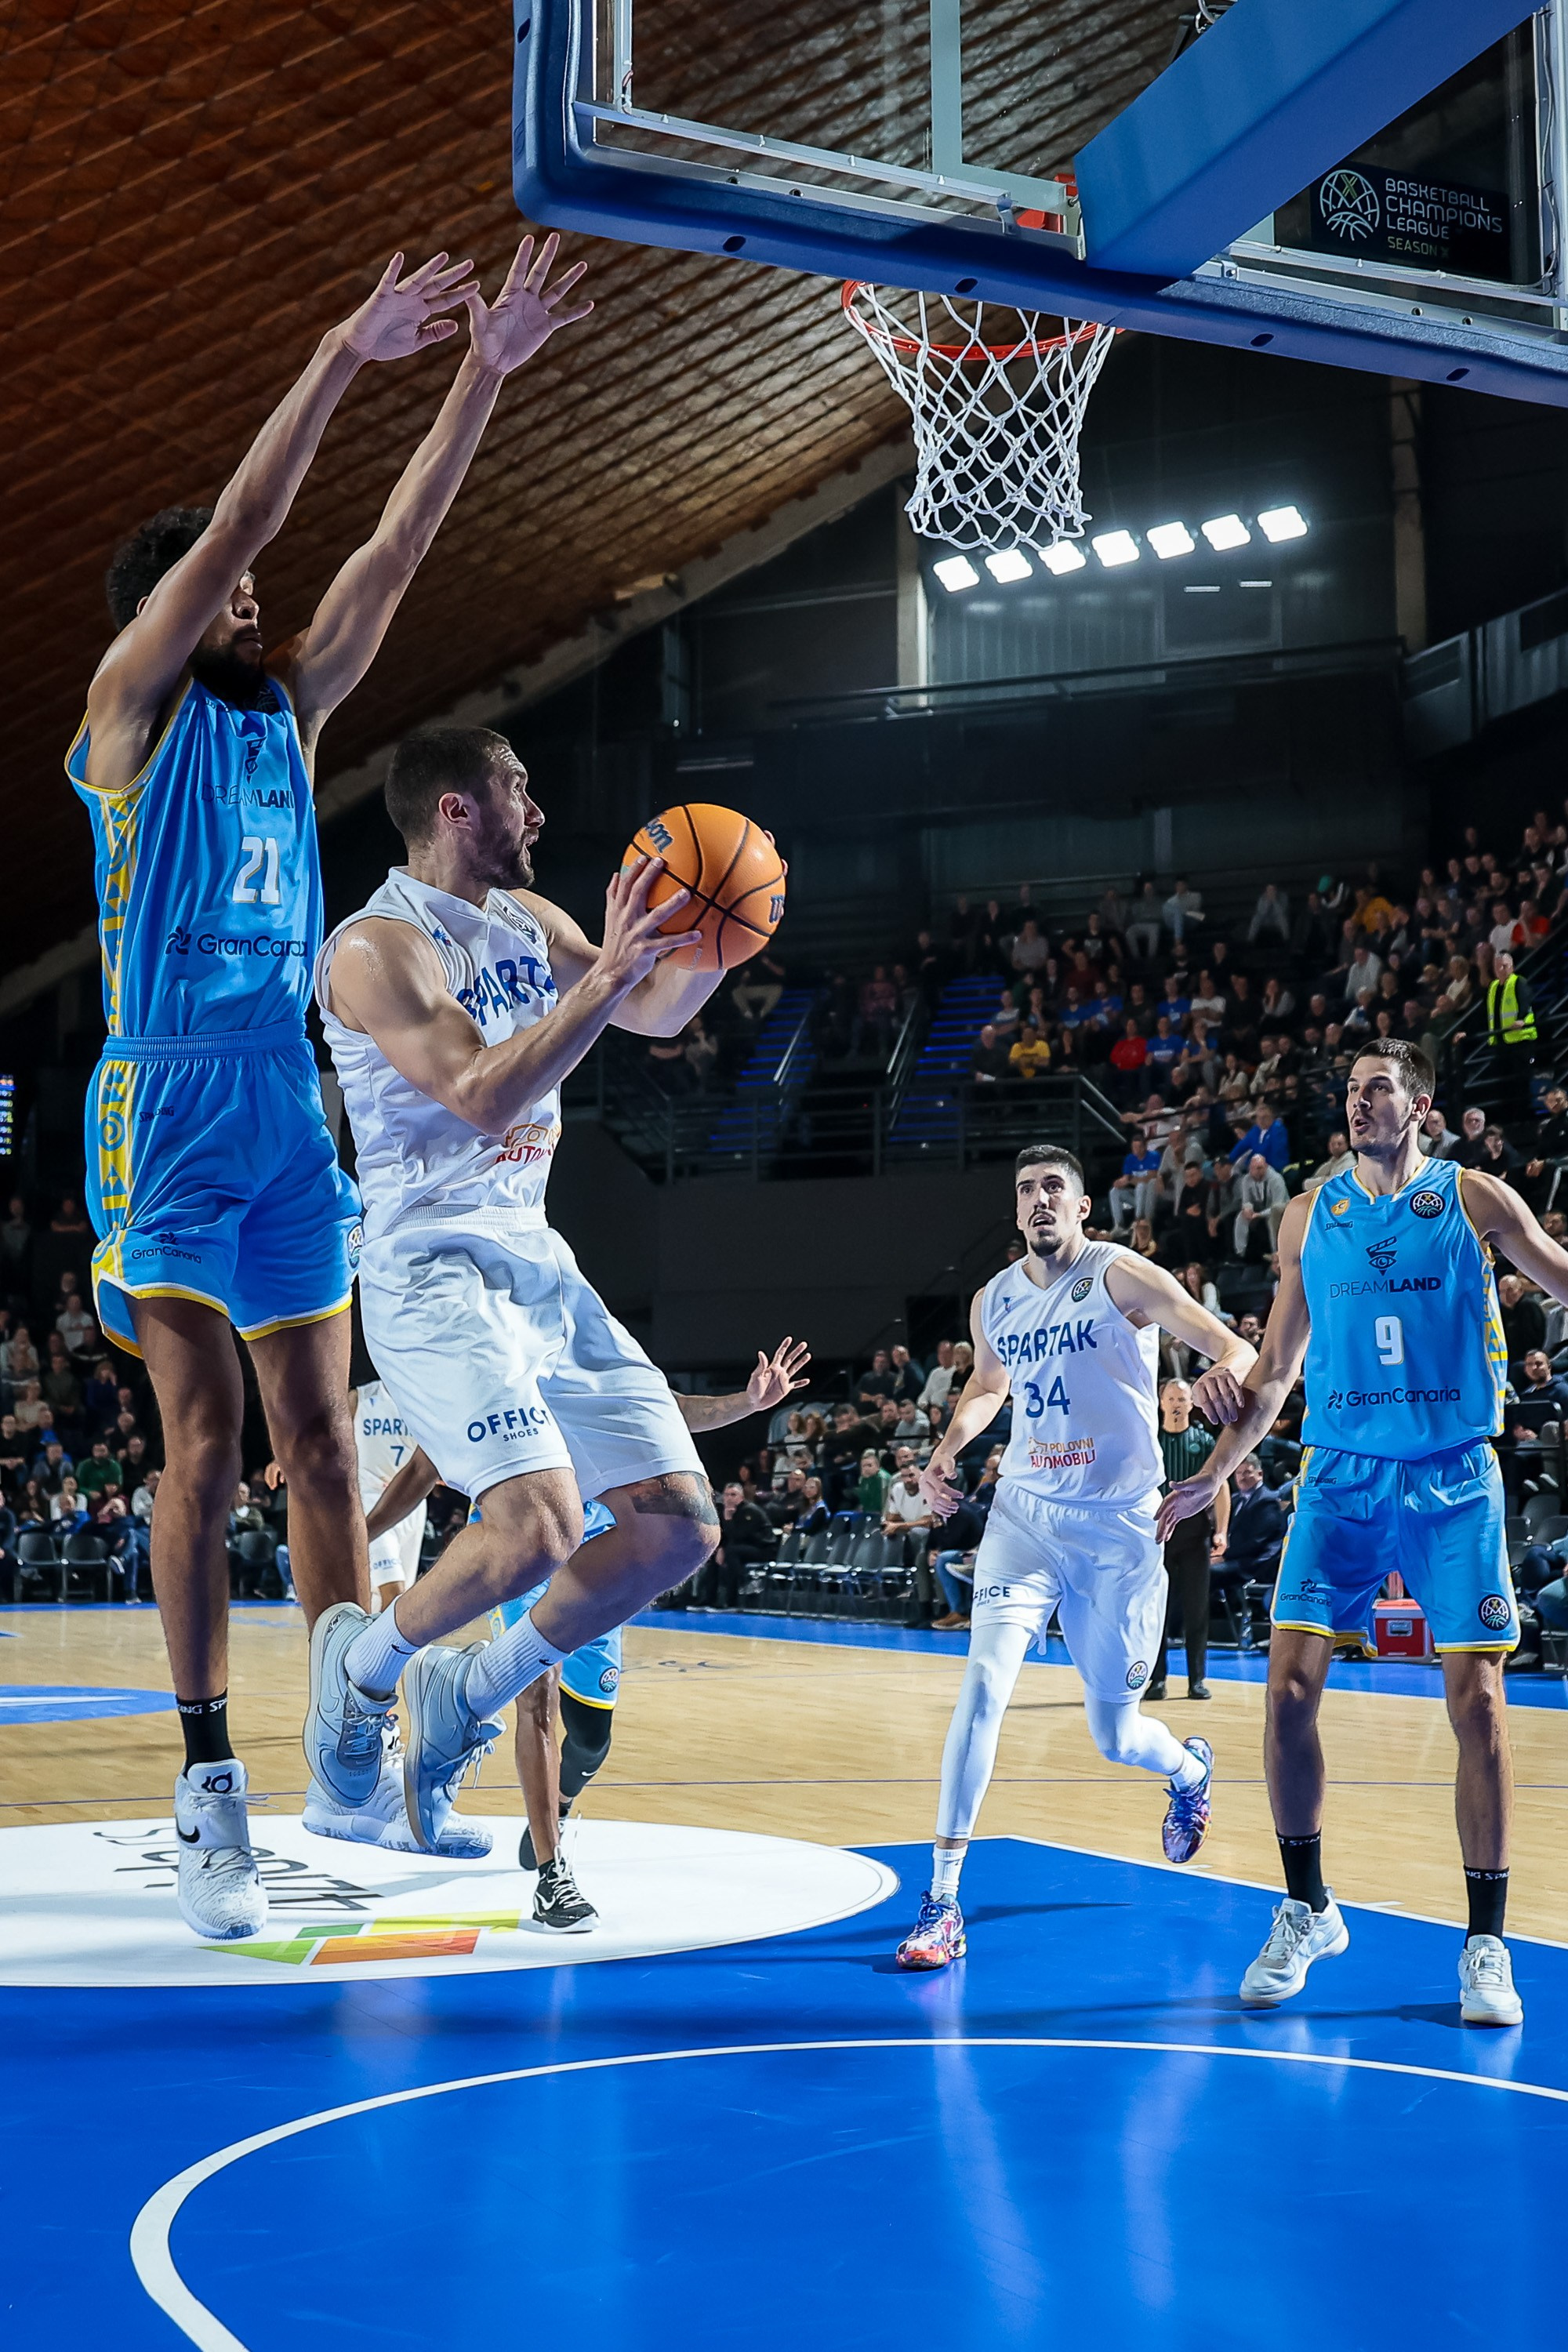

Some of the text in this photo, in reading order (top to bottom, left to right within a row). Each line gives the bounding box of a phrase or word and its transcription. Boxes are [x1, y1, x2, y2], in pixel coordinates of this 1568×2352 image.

[1386, 178, 1490, 212] BASKETBALL
[1386, 196, 1503, 234] CHAMPIONS
[1387, 215, 1450, 240] LEAGUE
[1388, 236, 1438, 256] SEASON
[233, 837, 280, 903] 21
[1330, 1276, 1441, 1298] DREAMLAND
[997, 1319, 1097, 1367] SPARTAK
[1375, 1316, 1403, 1365] 9
[1025, 1376, 1071, 1418] 34
[1346, 1385, 1461, 1406] GranCanaria
[503, 1428, 539, 1442] SHOES
[1050, 1437, 1094, 1454] POLOVNI
[390, 1446, 405, 1467] 7
